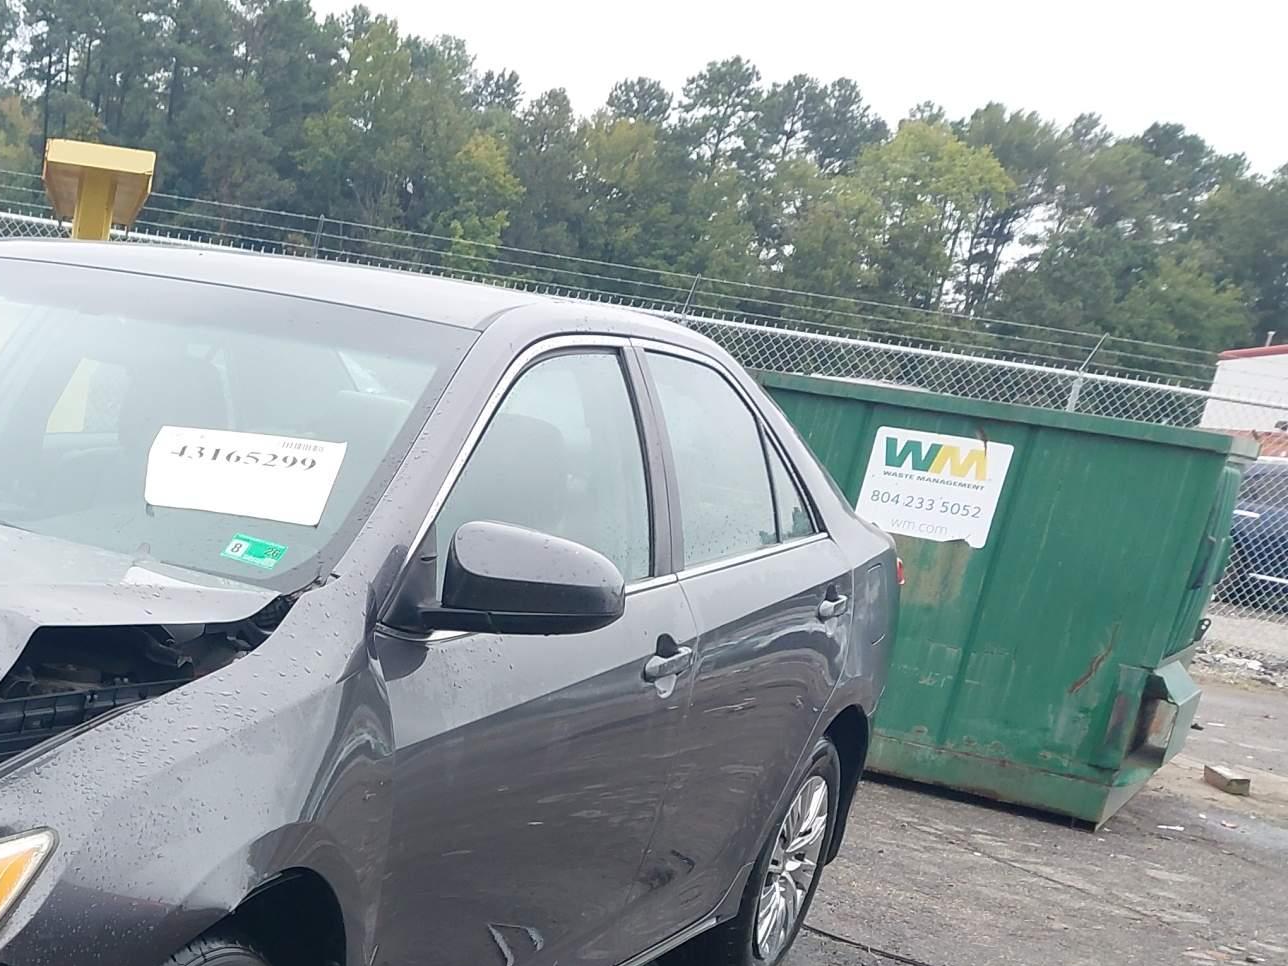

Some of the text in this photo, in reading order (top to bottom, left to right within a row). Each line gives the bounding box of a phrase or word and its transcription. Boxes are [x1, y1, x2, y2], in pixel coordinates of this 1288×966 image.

[171, 445, 317, 471] 43165299
[883, 470, 985, 491] WASTE MANAGEMENT
[870, 489, 981, 519] 804 233 5052
[230, 543, 242, 553] 8
